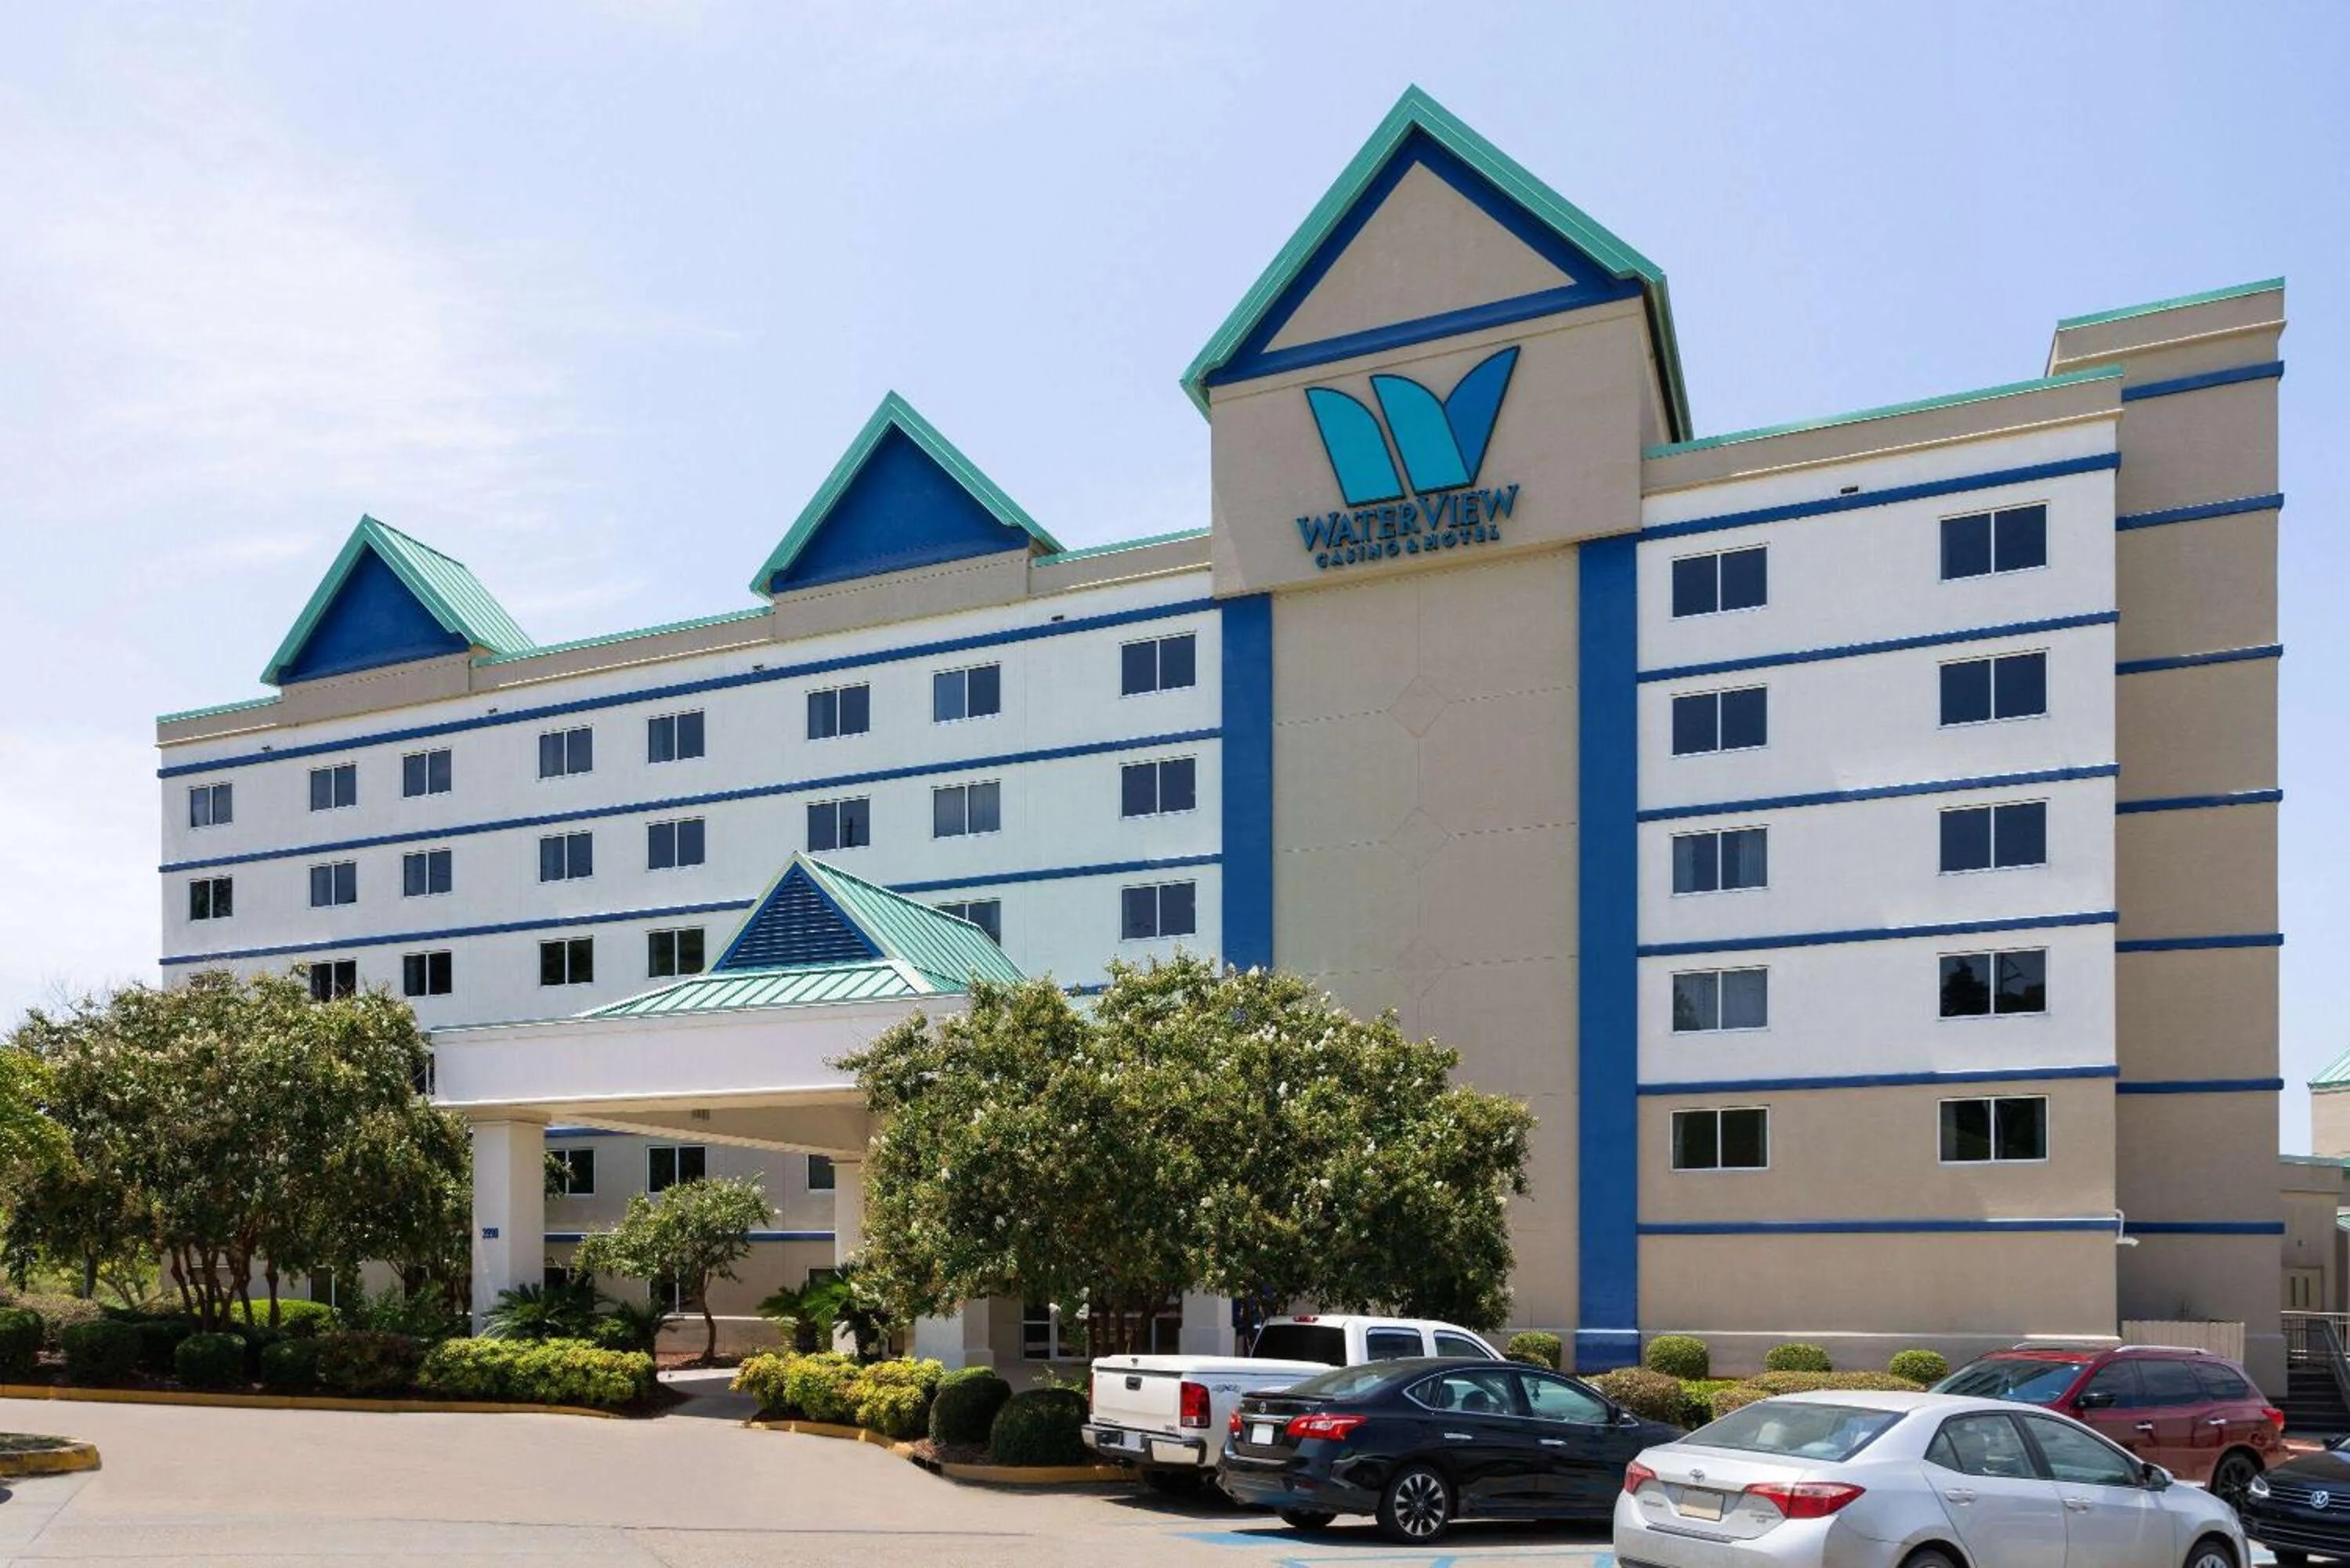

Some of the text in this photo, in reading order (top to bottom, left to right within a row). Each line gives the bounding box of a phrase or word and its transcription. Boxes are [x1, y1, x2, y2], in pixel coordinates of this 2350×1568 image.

[1296, 483, 1520, 551] WATERVIEW
[1315, 540, 1401, 569] CASINO
[1423, 524, 1501, 551] HOTEL
